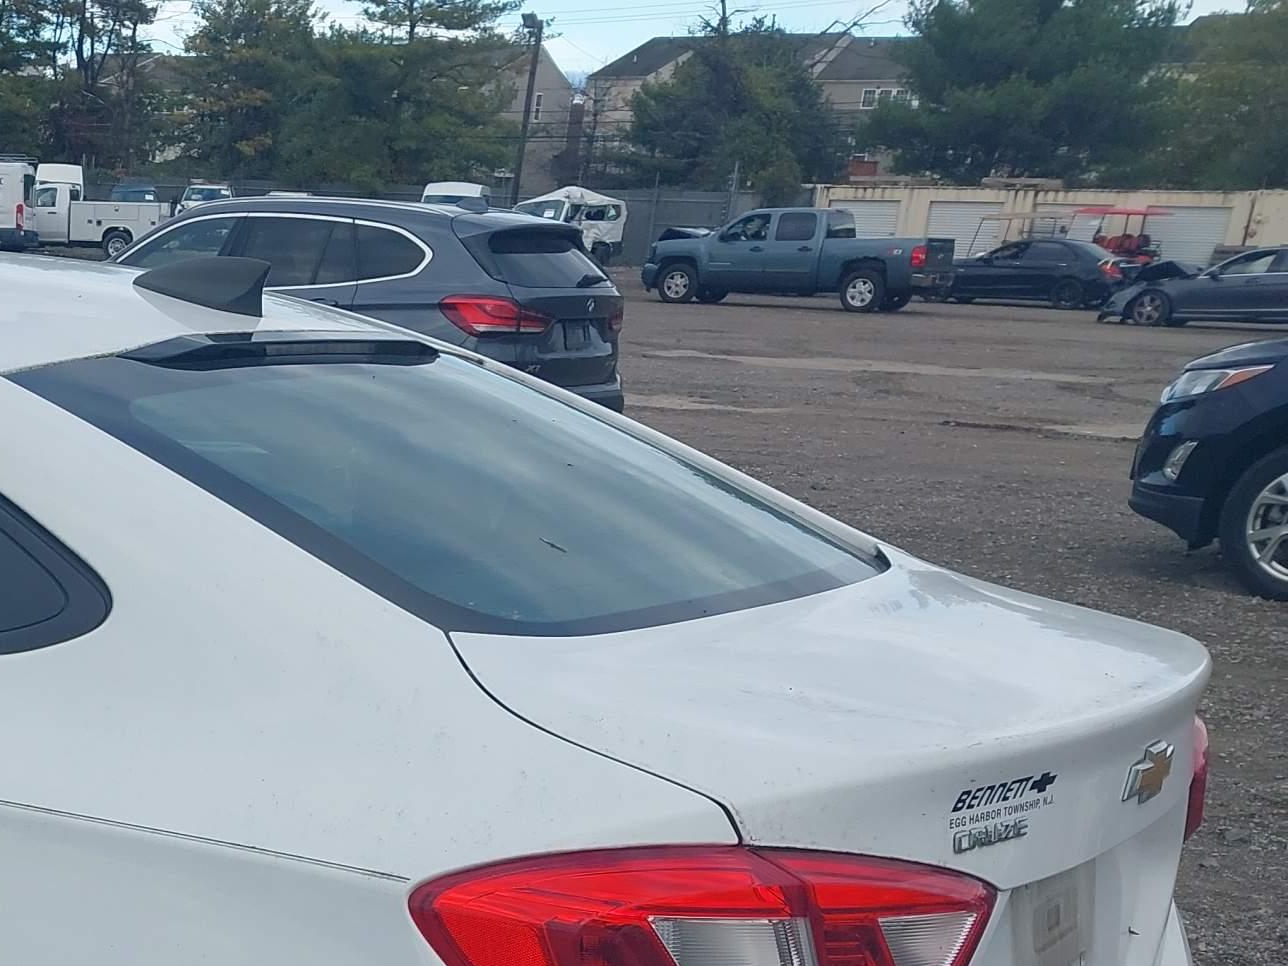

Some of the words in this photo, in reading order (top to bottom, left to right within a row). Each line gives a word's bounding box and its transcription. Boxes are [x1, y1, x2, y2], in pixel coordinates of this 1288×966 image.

[951, 776, 1034, 813] BENNETT
[949, 816, 967, 830] EGG
[968, 808, 1002, 825] HARBOR
[1003, 798, 1041, 816] TOWNSHIP,
[952, 815, 1029, 854] CRUZE
